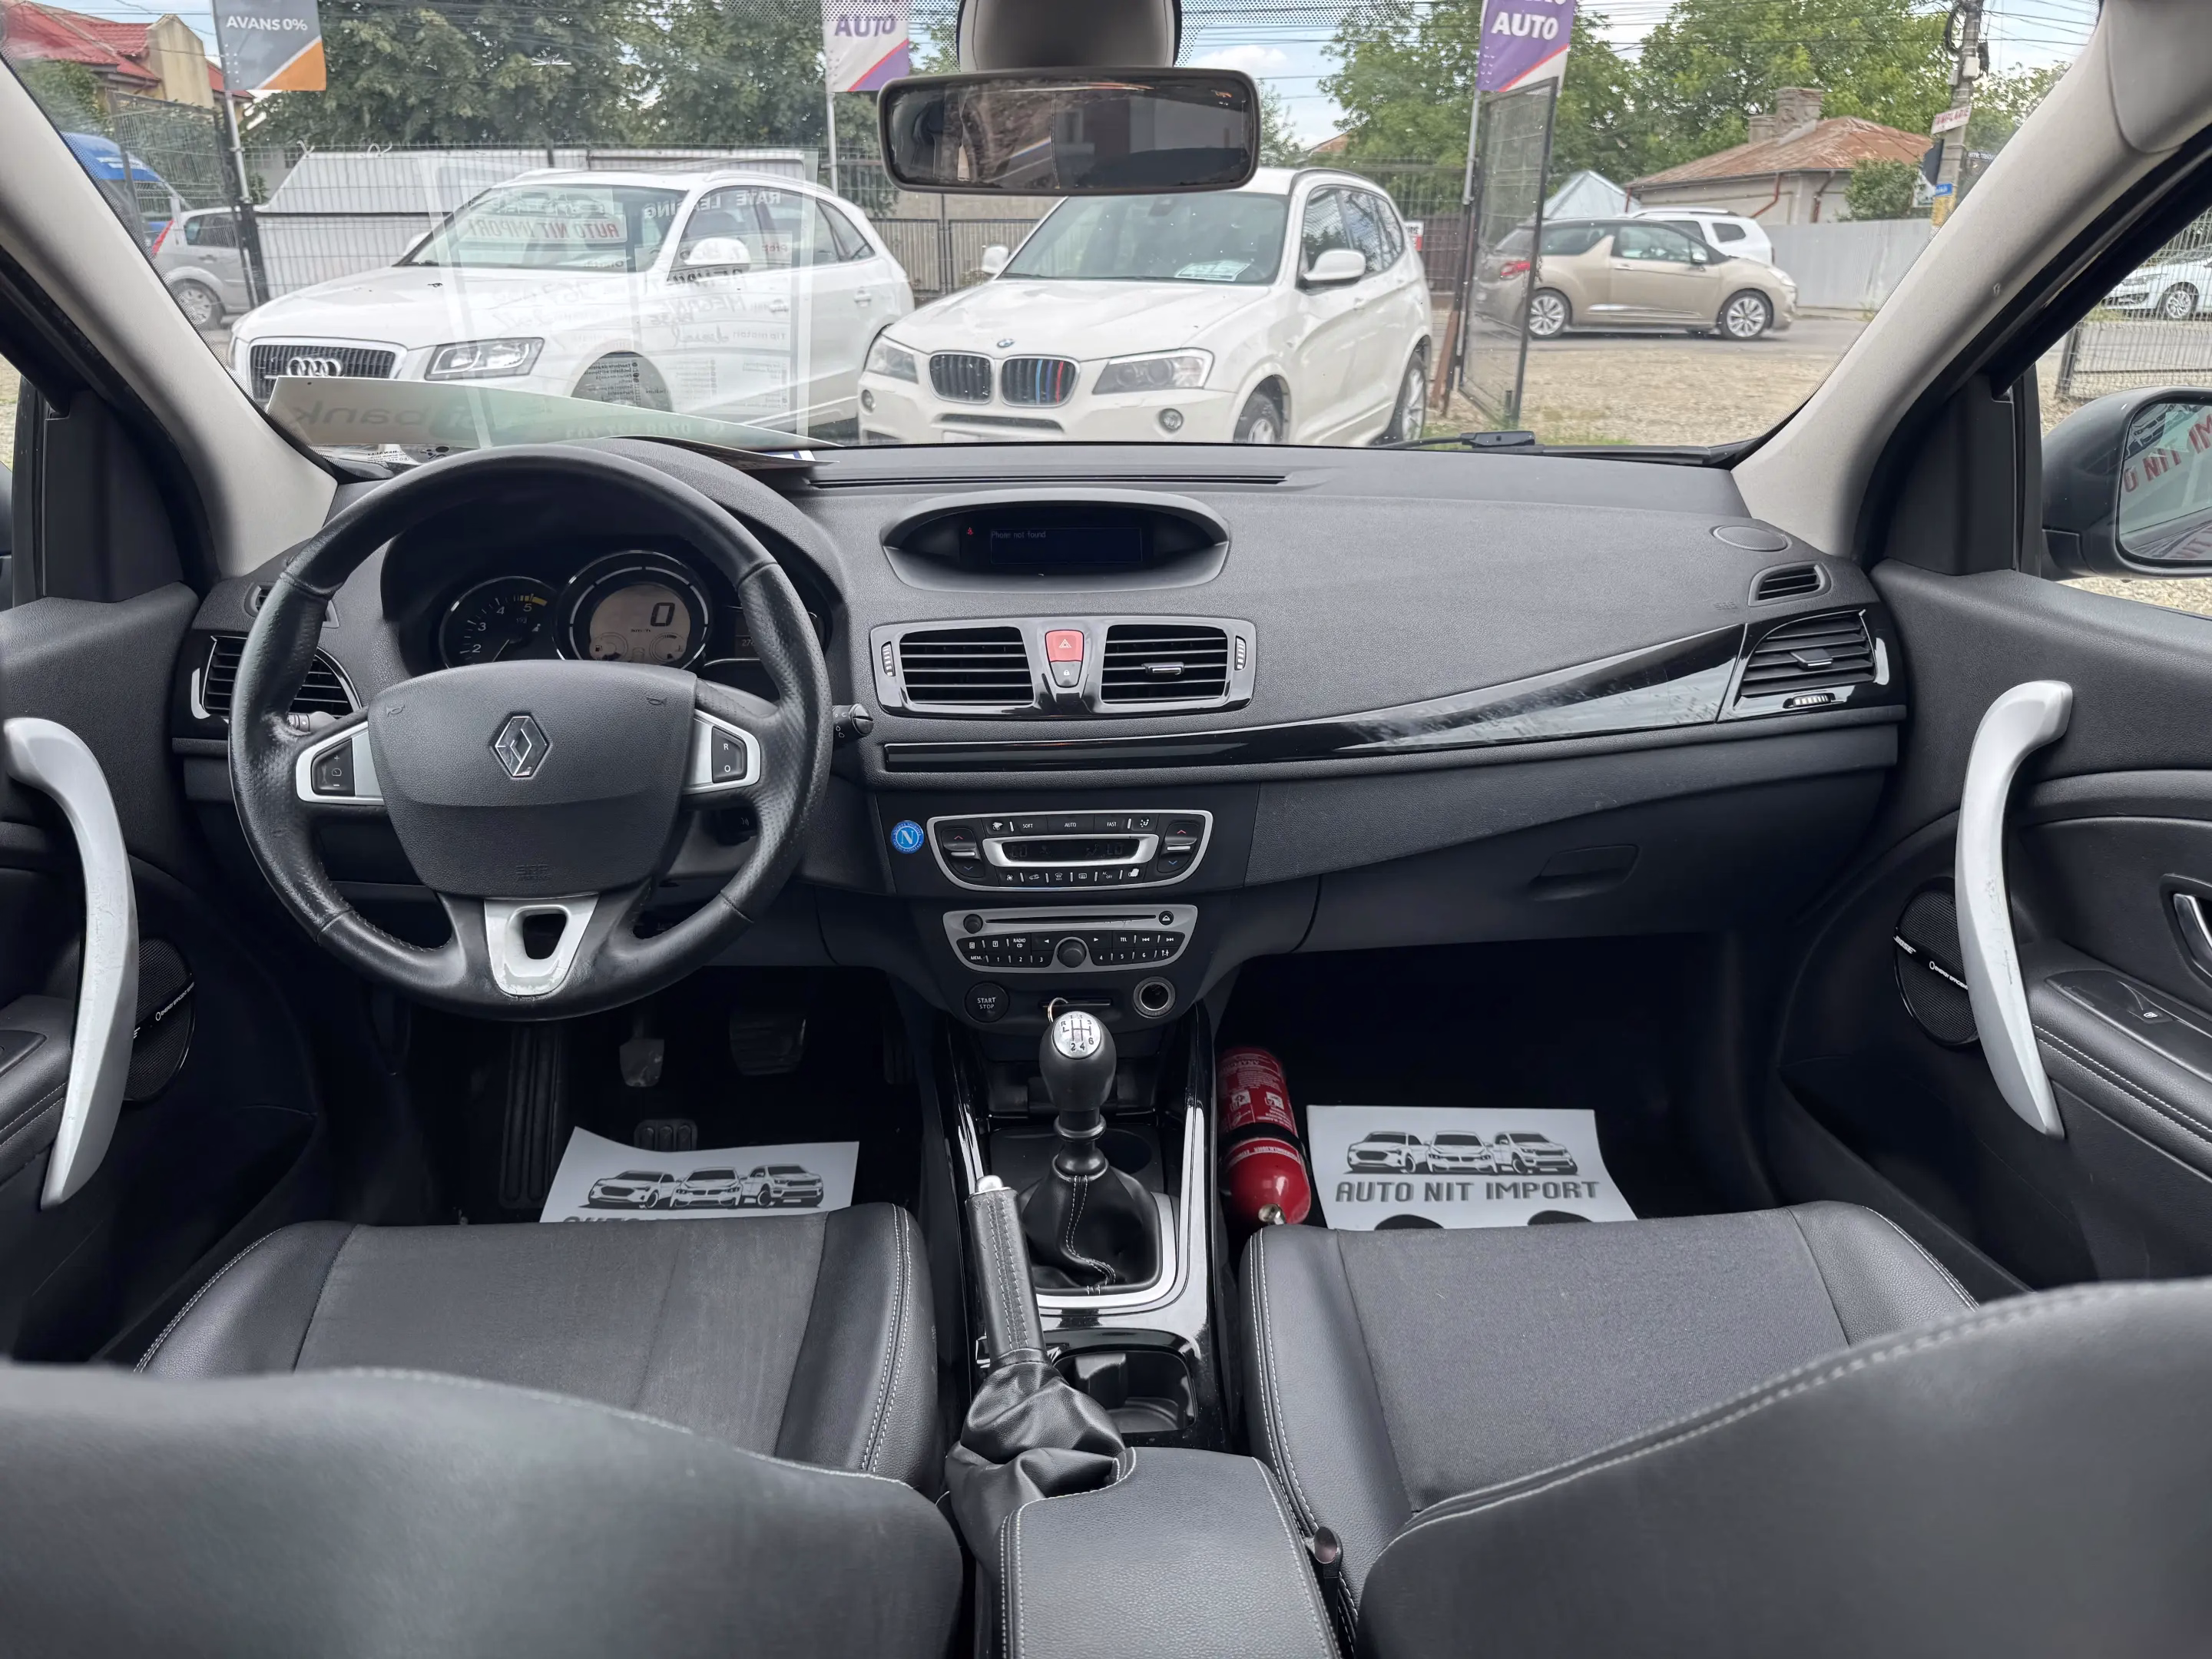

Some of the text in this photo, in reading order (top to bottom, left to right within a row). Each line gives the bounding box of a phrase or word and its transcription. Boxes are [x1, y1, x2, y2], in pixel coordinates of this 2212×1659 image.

[226, 15, 308, 31] AVANS 0%
[834, 14, 897, 37] AUTO
[1491, 11, 1559, 40] AUTO
[1027, 530, 1046, 538] found
[496, 606, 505, 615] 4
[523, 603, 532, 612] 5
[650, 601, 676, 627] 0
[478, 622, 487, 631] 3
[472, 644, 482, 653] 2
[900, 830, 914, 845] N
[1892, 935, 1916, 955] BOSE
[1088, 1037, 1094, 1045] 6
[1071, 1042, 1076, 1051] 2
[1079, 1042, 1085, 1051] 4
[1335, 1180, 1600, 1203] AUTO NIT IMPORT
